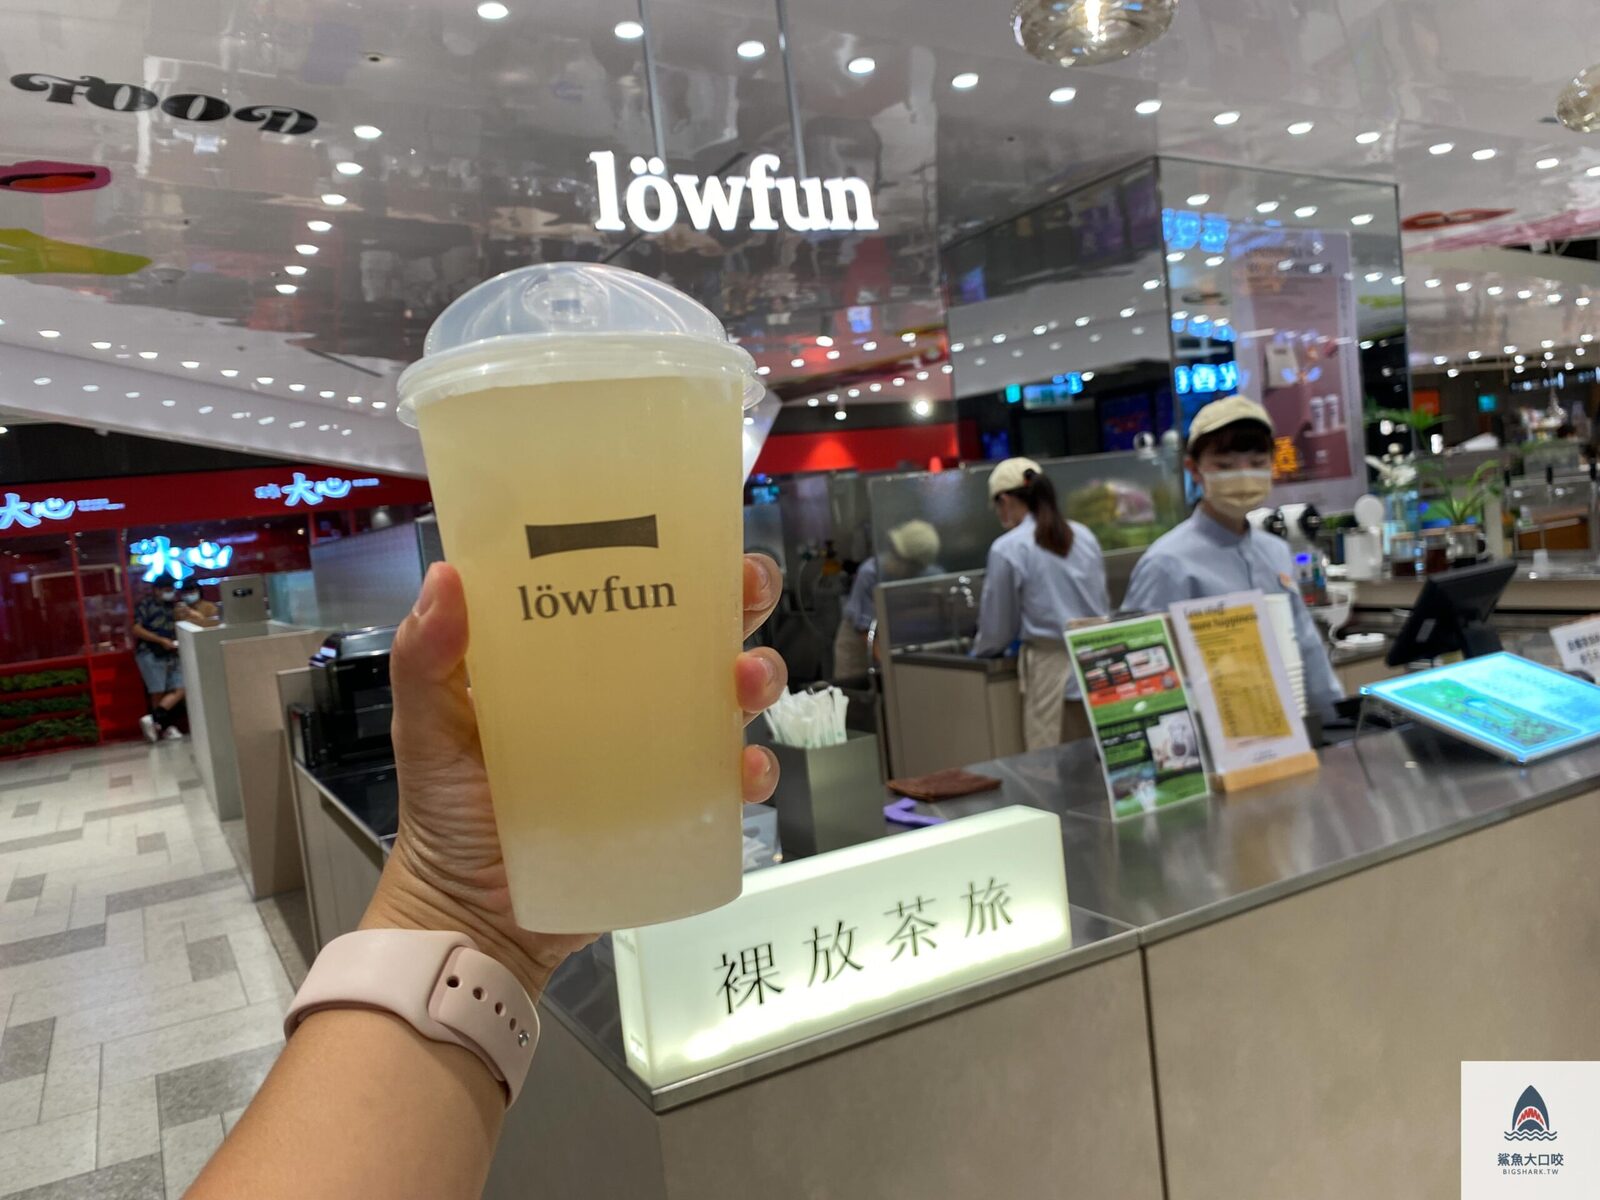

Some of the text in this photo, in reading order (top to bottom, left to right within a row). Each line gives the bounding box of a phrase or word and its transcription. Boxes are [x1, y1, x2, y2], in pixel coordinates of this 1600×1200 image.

[10, 73, 318, 134] FOOD
[587, 150, 879, 232] löwfun
[516, 575, 677, 621] löwfun
[714, 877, 1014, 1015] 裸放茶旅
